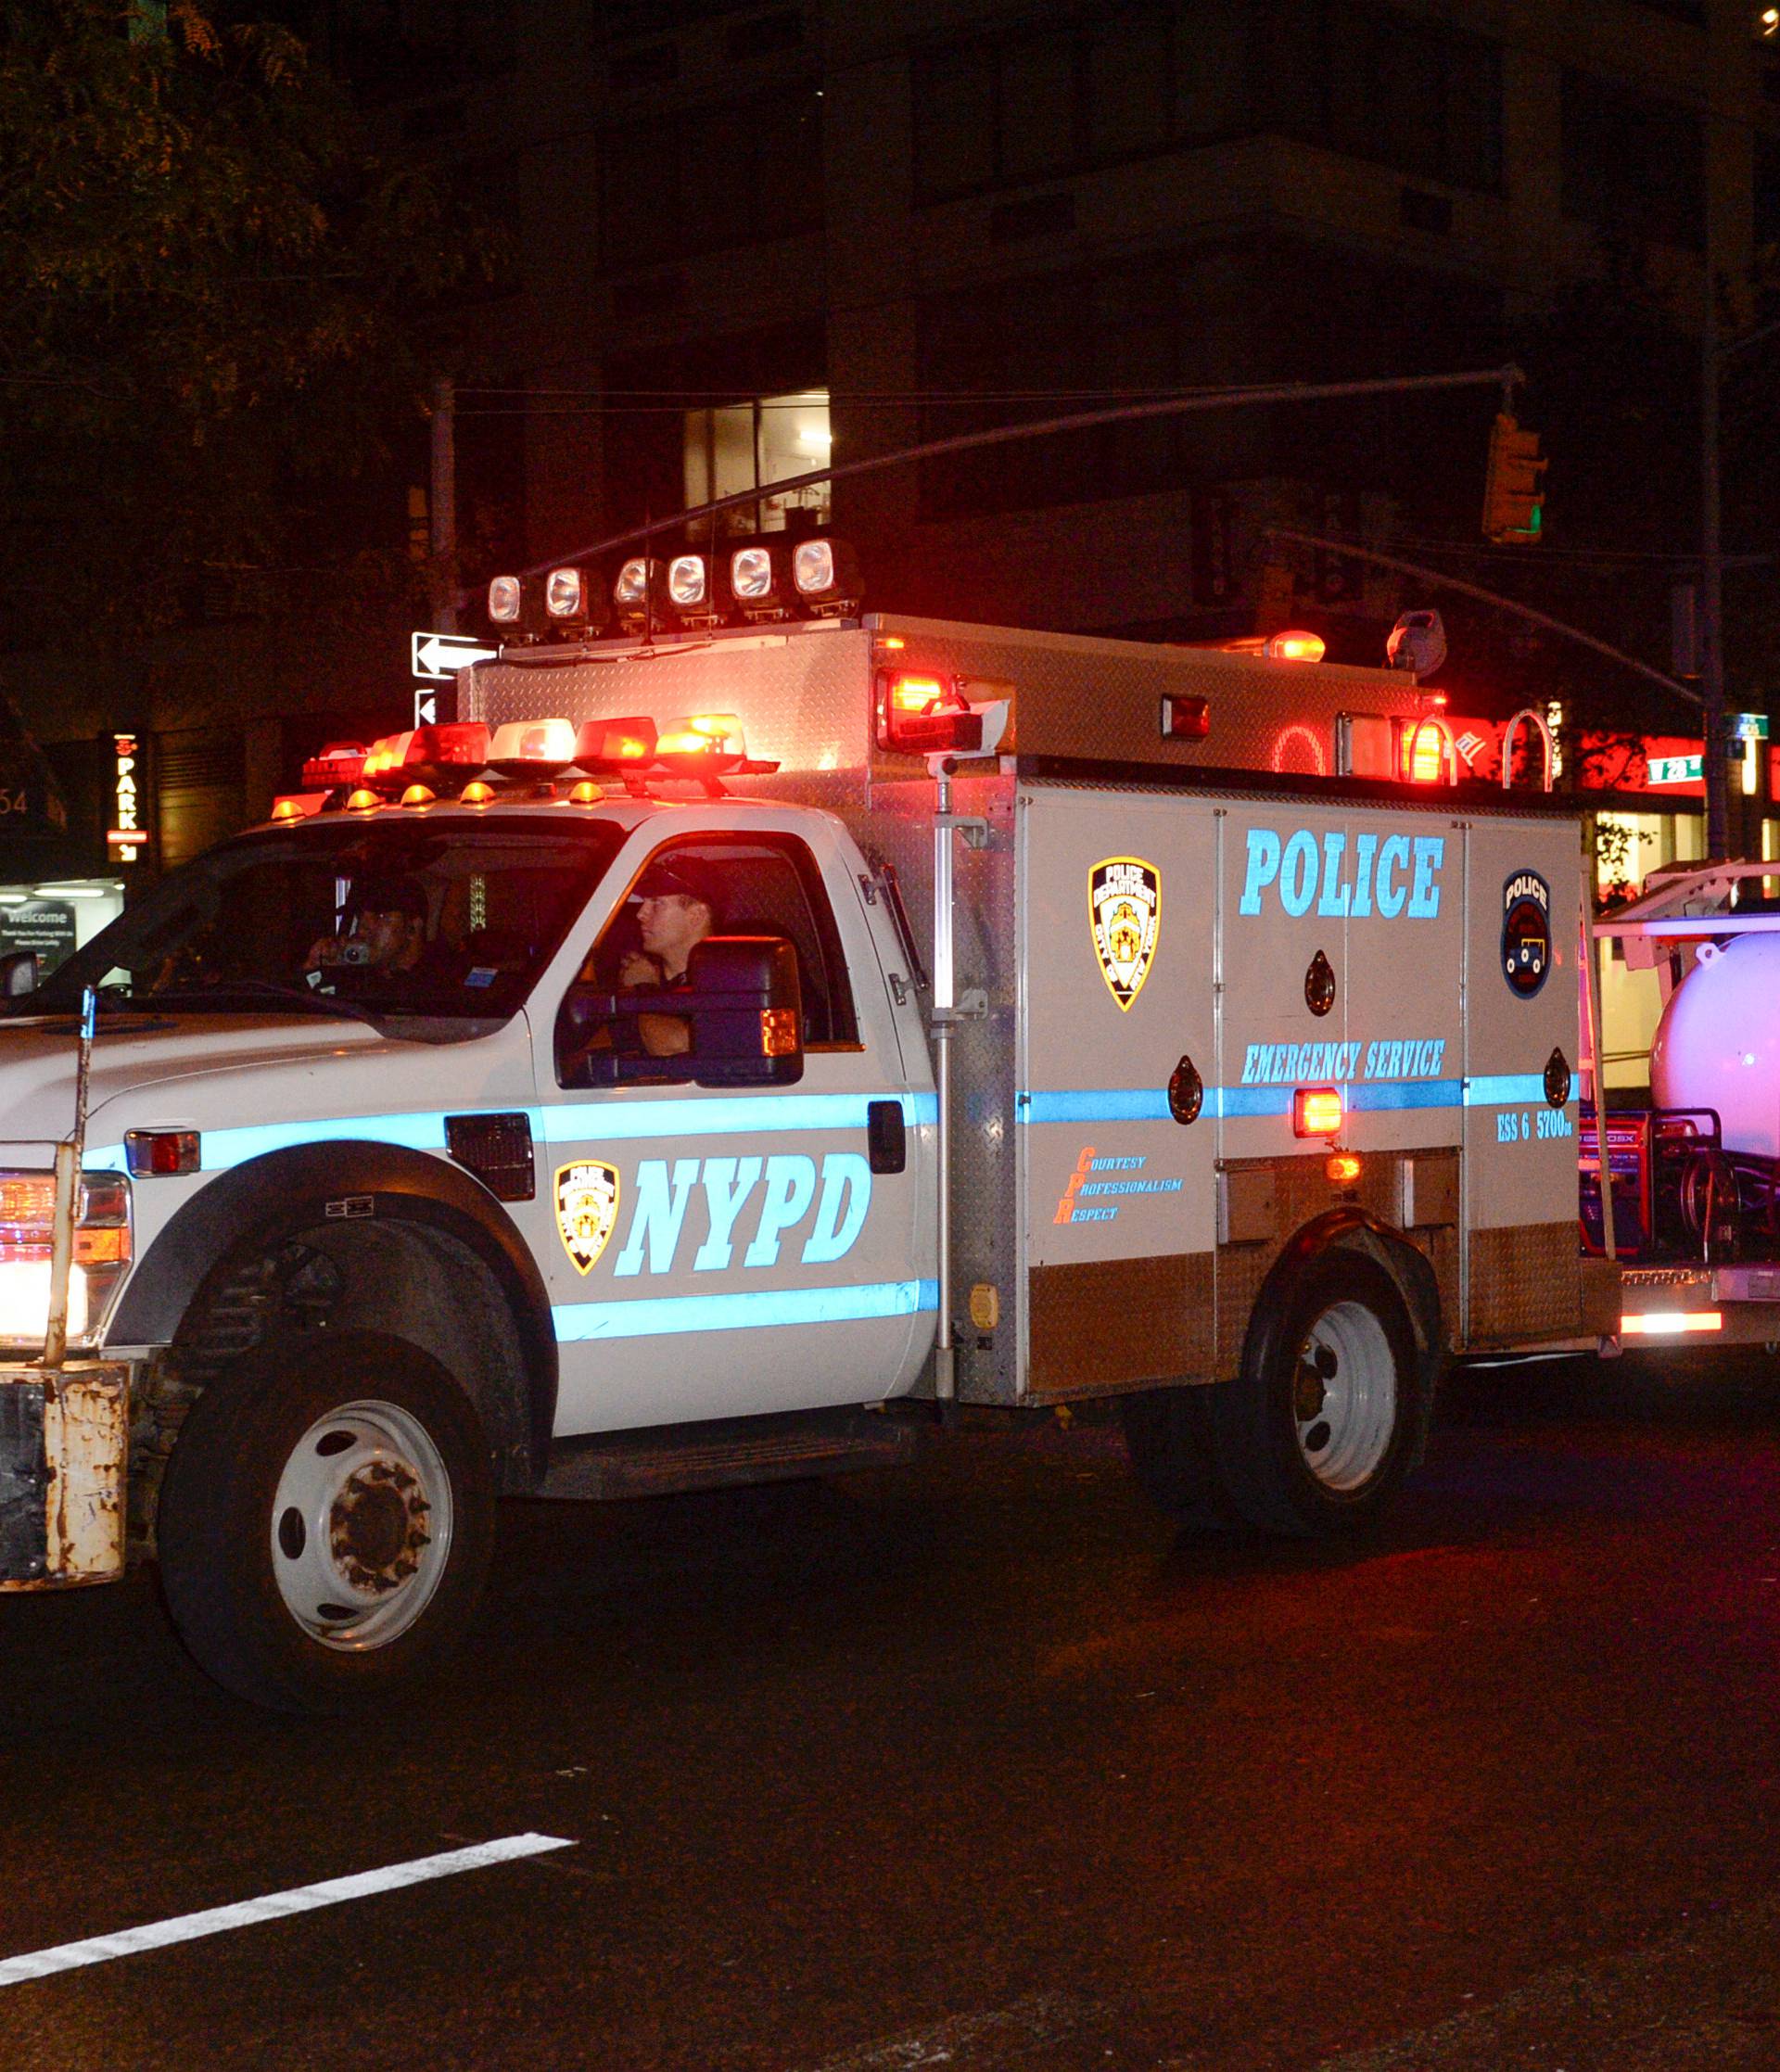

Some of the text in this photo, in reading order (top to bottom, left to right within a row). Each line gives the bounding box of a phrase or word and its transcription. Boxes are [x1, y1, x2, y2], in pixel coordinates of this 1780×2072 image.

[116, 756, 137, 830] PARK
[1106, 864, 1145, 883] POLICE
[1239, 829, 1445, 919] POLICE
[1093, 880, 1156, 909] DEPARTMENT
[1506, 875, 1547, 911] POLICE
[8, 909, 68, 923] Welcome
[1241, 1038, 1445, 1084] EMERGENCY SERVICE
[1497, 1112, 1519, 1142] ESS
[1521, 1112, 1530, 1140] 6
[1076, 1147, 1147, 1173] COURTESY
[1064, 1172, 1183, 1198] PROFESSIONALISM
[614, 1152, 872, 1277] NYPD
[1053, 1198, 1118, 1224] RESPECT
